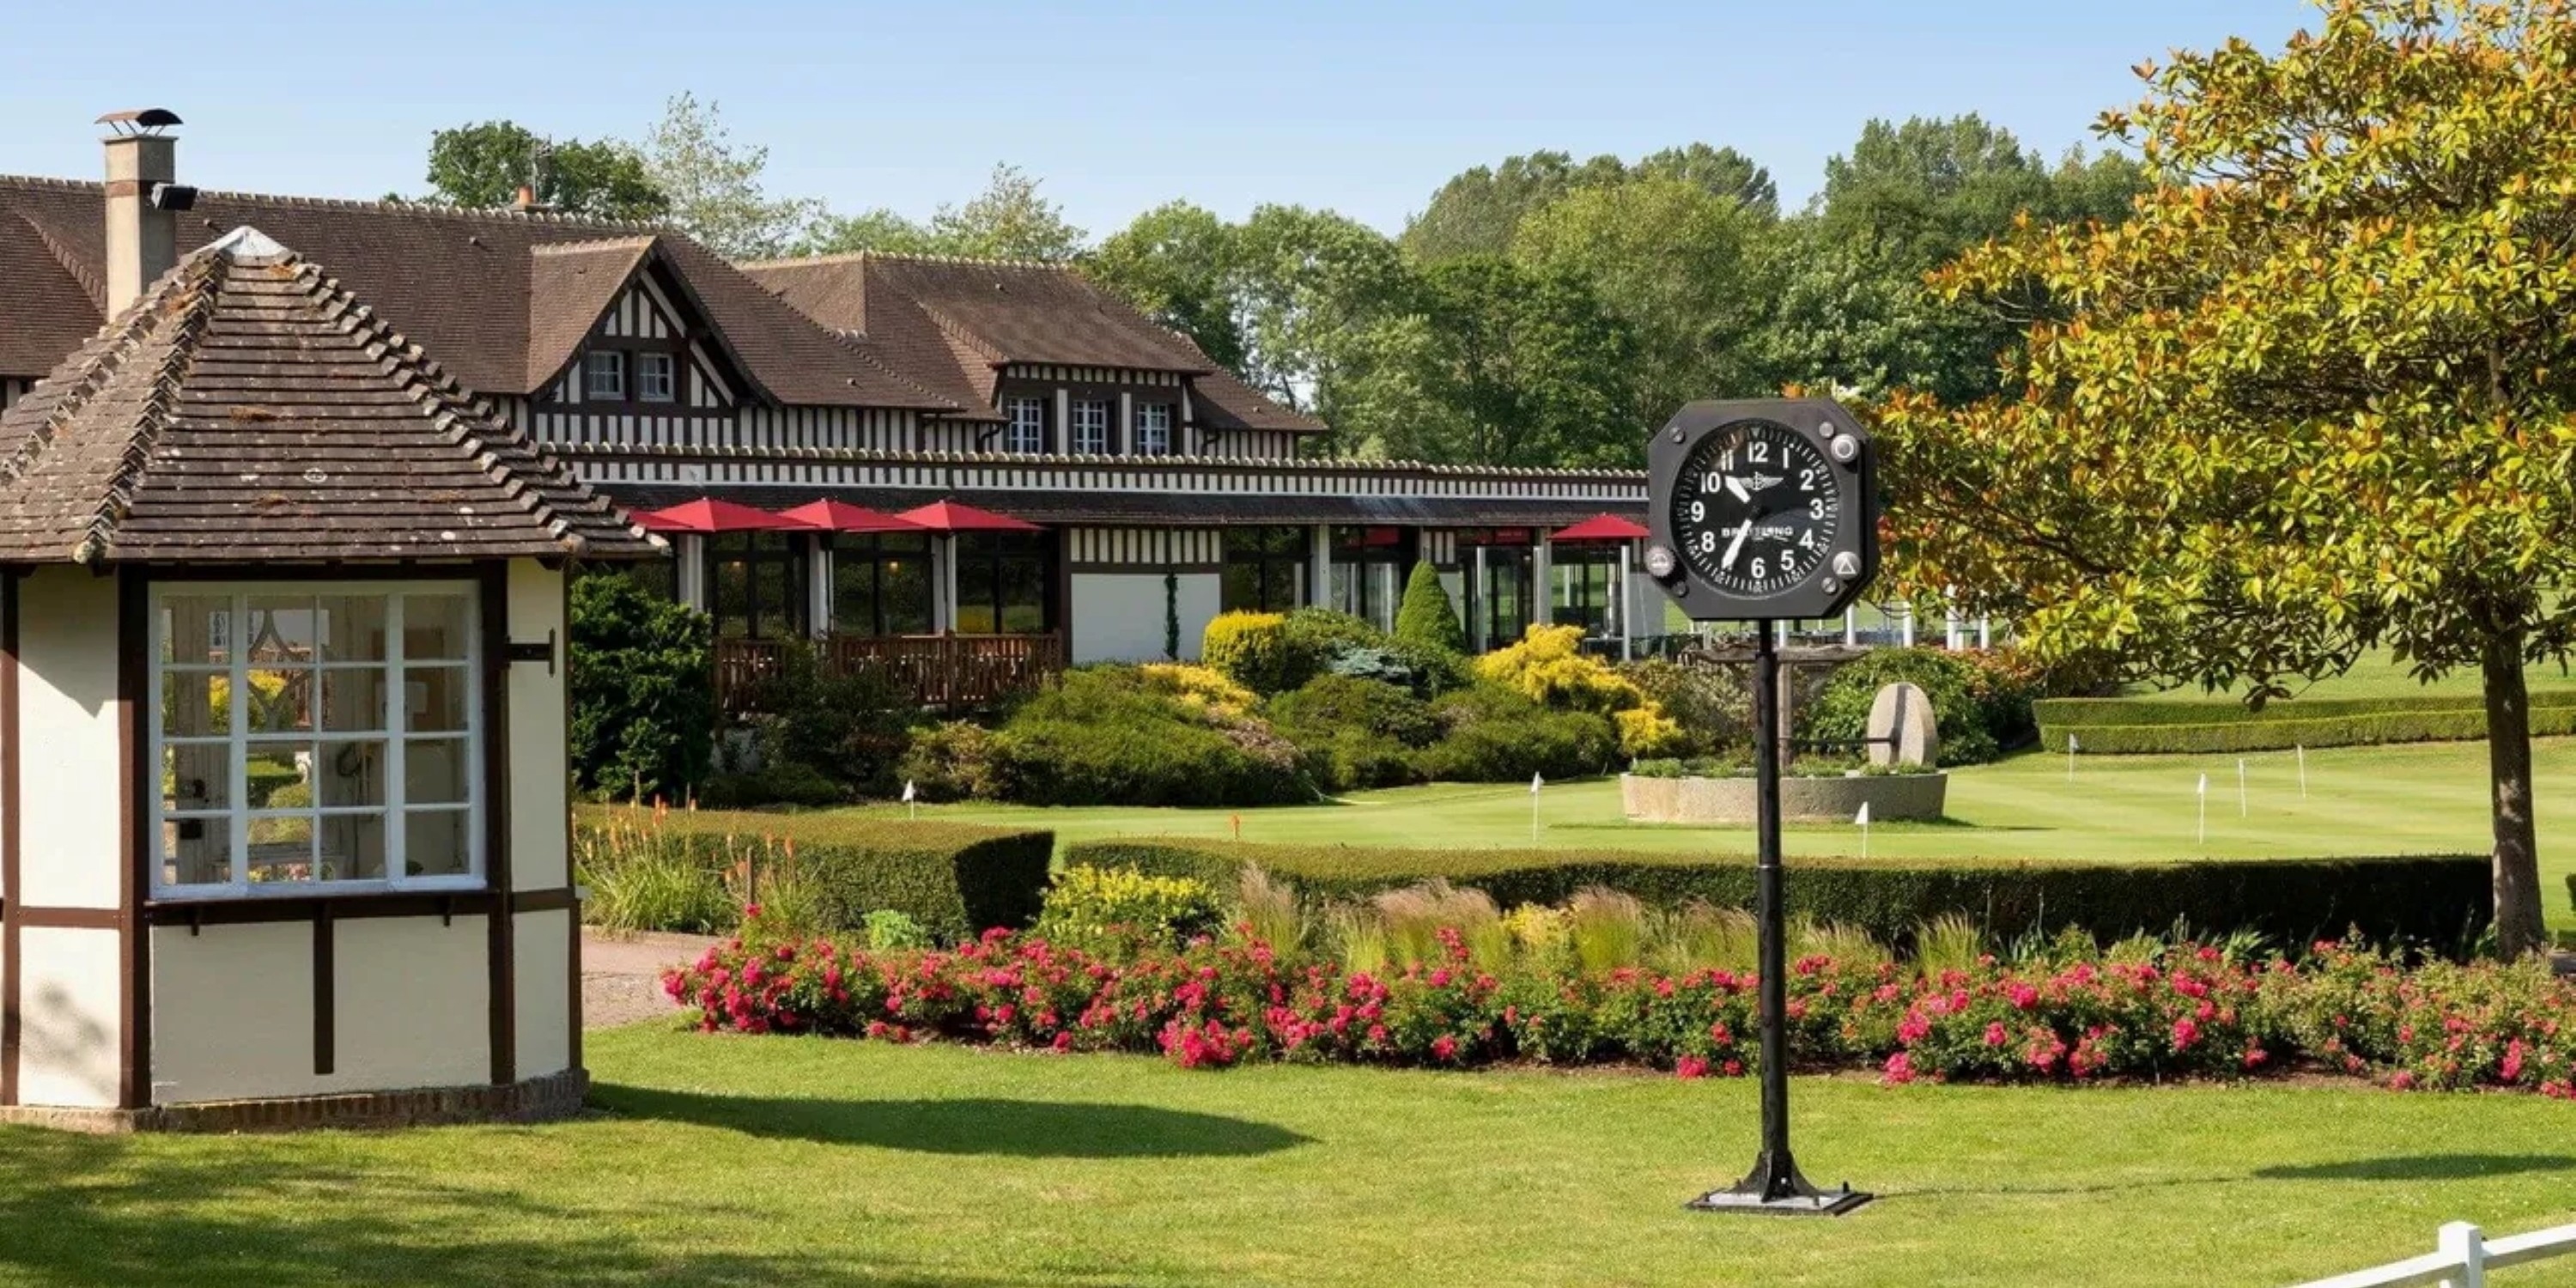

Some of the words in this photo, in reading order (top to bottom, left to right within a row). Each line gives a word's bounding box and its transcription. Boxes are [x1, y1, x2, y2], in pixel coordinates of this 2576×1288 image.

[1722, 449, 1734, 471] 11
[1748, 441, 1769, 463] 12
[1783, 447, 1789, 469] 1
[1701, 471, 1721, 493] 10
[1800, 469, 1814, 490] 2
[1691, 501, 1704, 522] 9
[1809, 498, 1824, 520] 3
[1701, 531, 1716, 552] 8
[1799, 528, 1814, 550] 4
[1751, 557, 1766, 579] 6
[1780, 550, 1795, 571] 5
